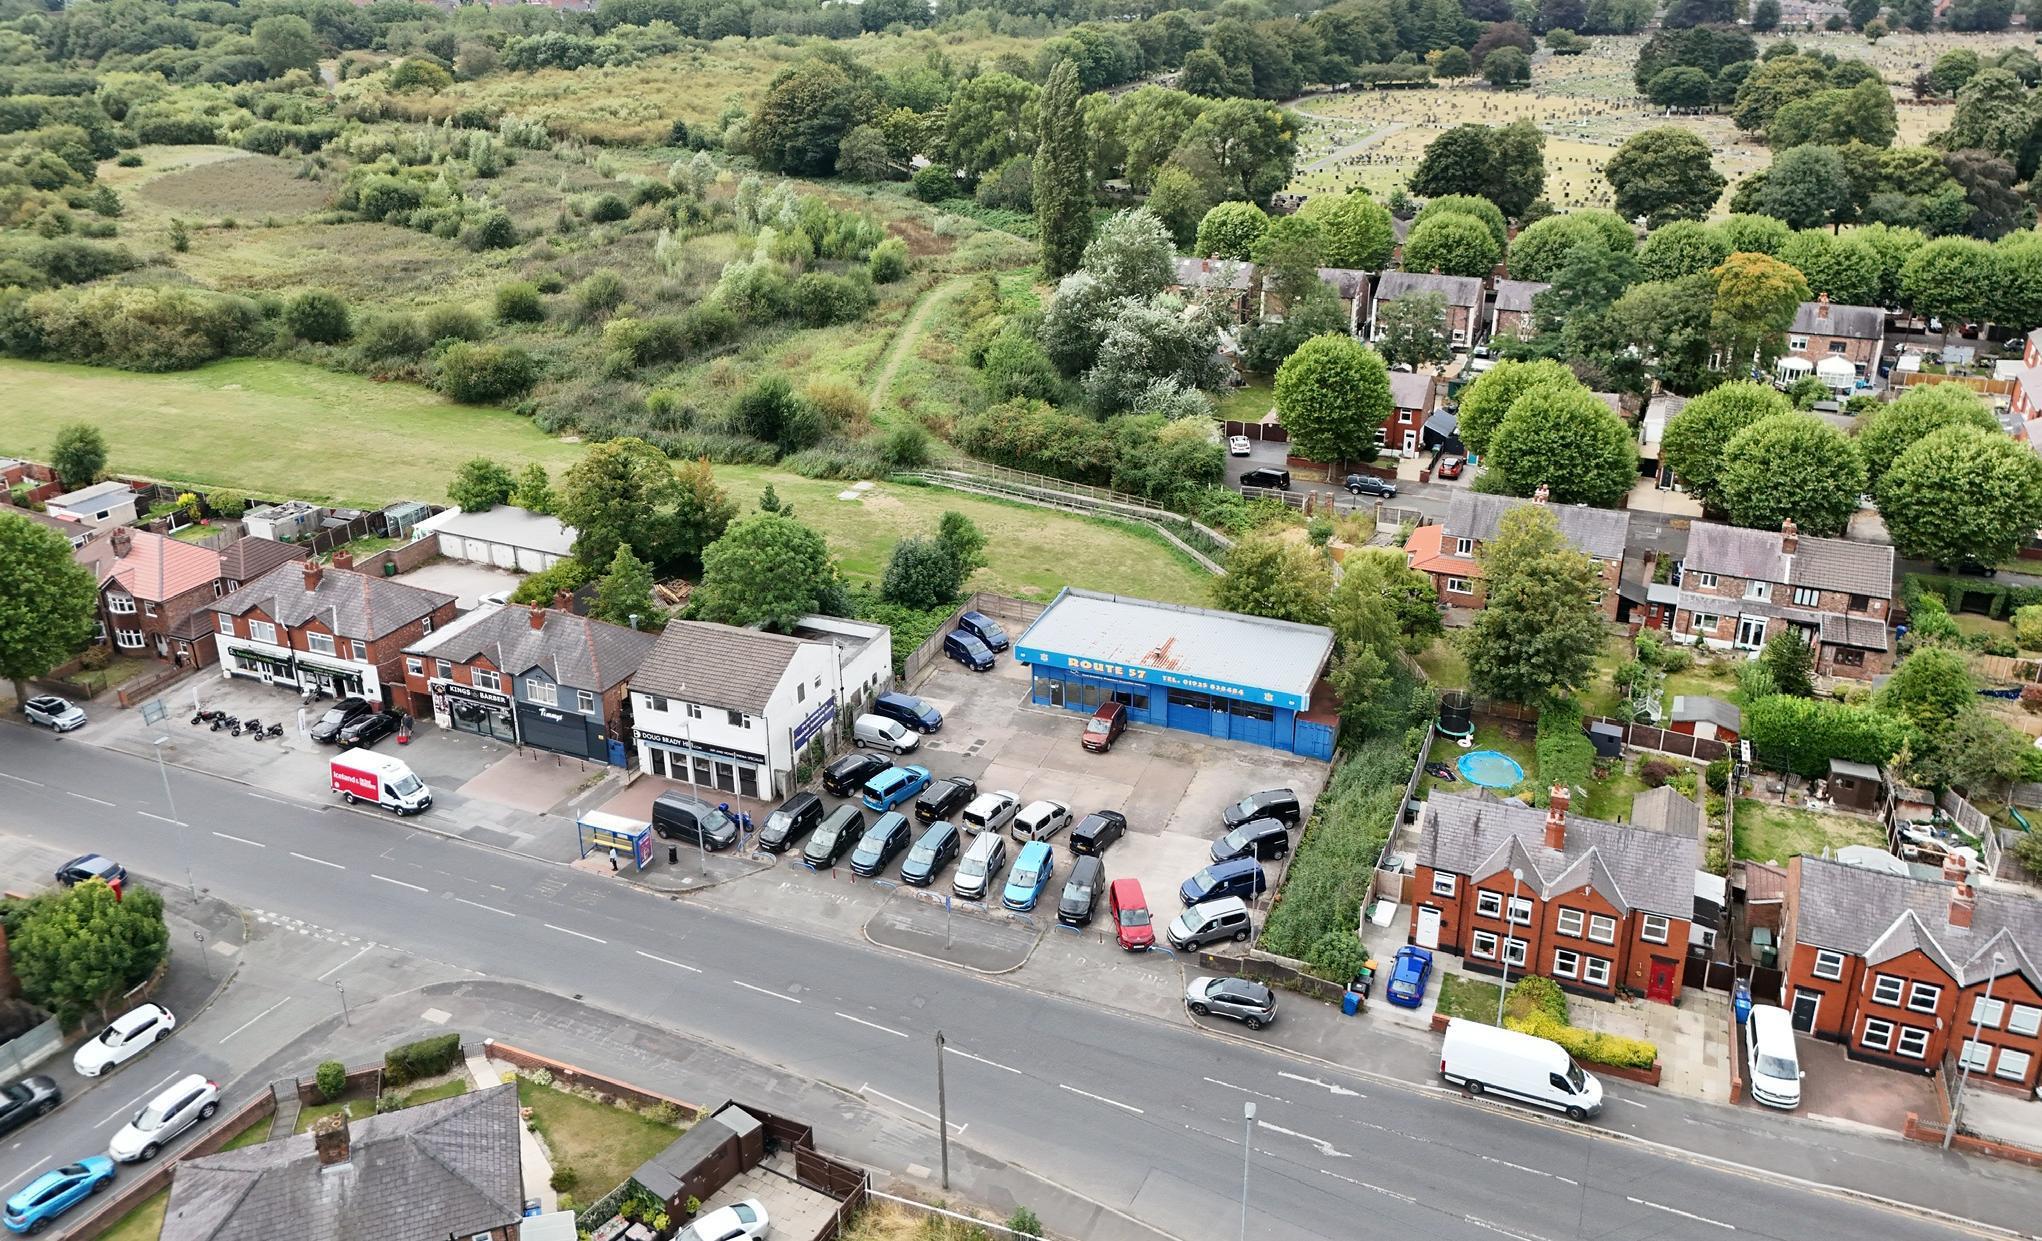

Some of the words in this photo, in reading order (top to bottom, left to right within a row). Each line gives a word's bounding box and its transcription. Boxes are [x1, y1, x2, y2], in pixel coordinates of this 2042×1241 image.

[1068, 657, 1123, 675] ROUTE
[1128, 668, 1146, 680] 57
[1162, 675, 1181, 684] TEL.
[449, 685, 471, 696] KINGS
[479, 692, 506, 704] BARBER
[642, 732, 661, 742] DOUG
[662, 736, 681, 746] BRADY
[333, 771, 356, 783] Iceland
